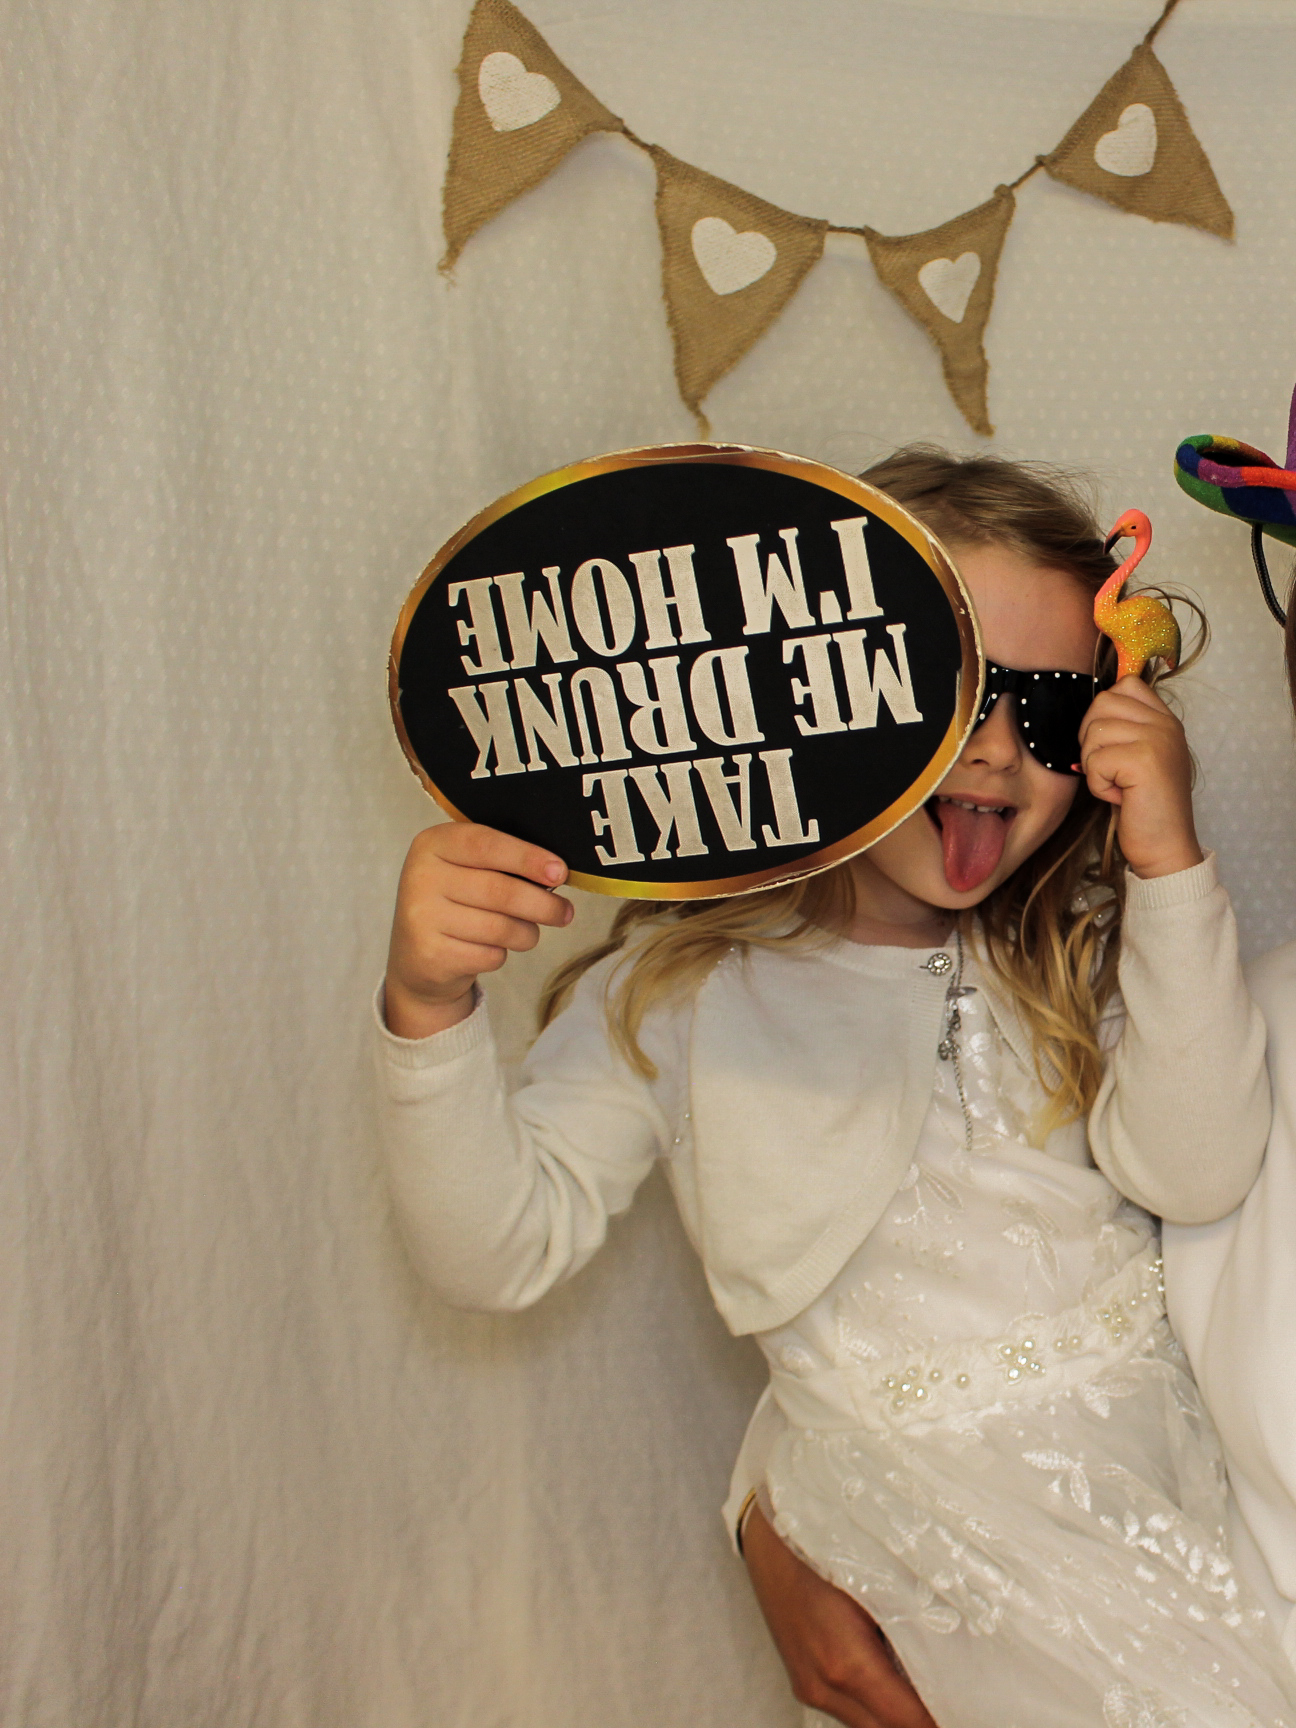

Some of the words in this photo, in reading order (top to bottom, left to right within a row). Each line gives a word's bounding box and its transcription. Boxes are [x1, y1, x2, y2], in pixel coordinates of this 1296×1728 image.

[448, 544, 712, 676] HOME
[726, 516, 884, 636] I'M
[448, 645, 765, 780] DRUNK
[782, 623, 923, 737] ME
[582, 748, 820, 866] TAKE
